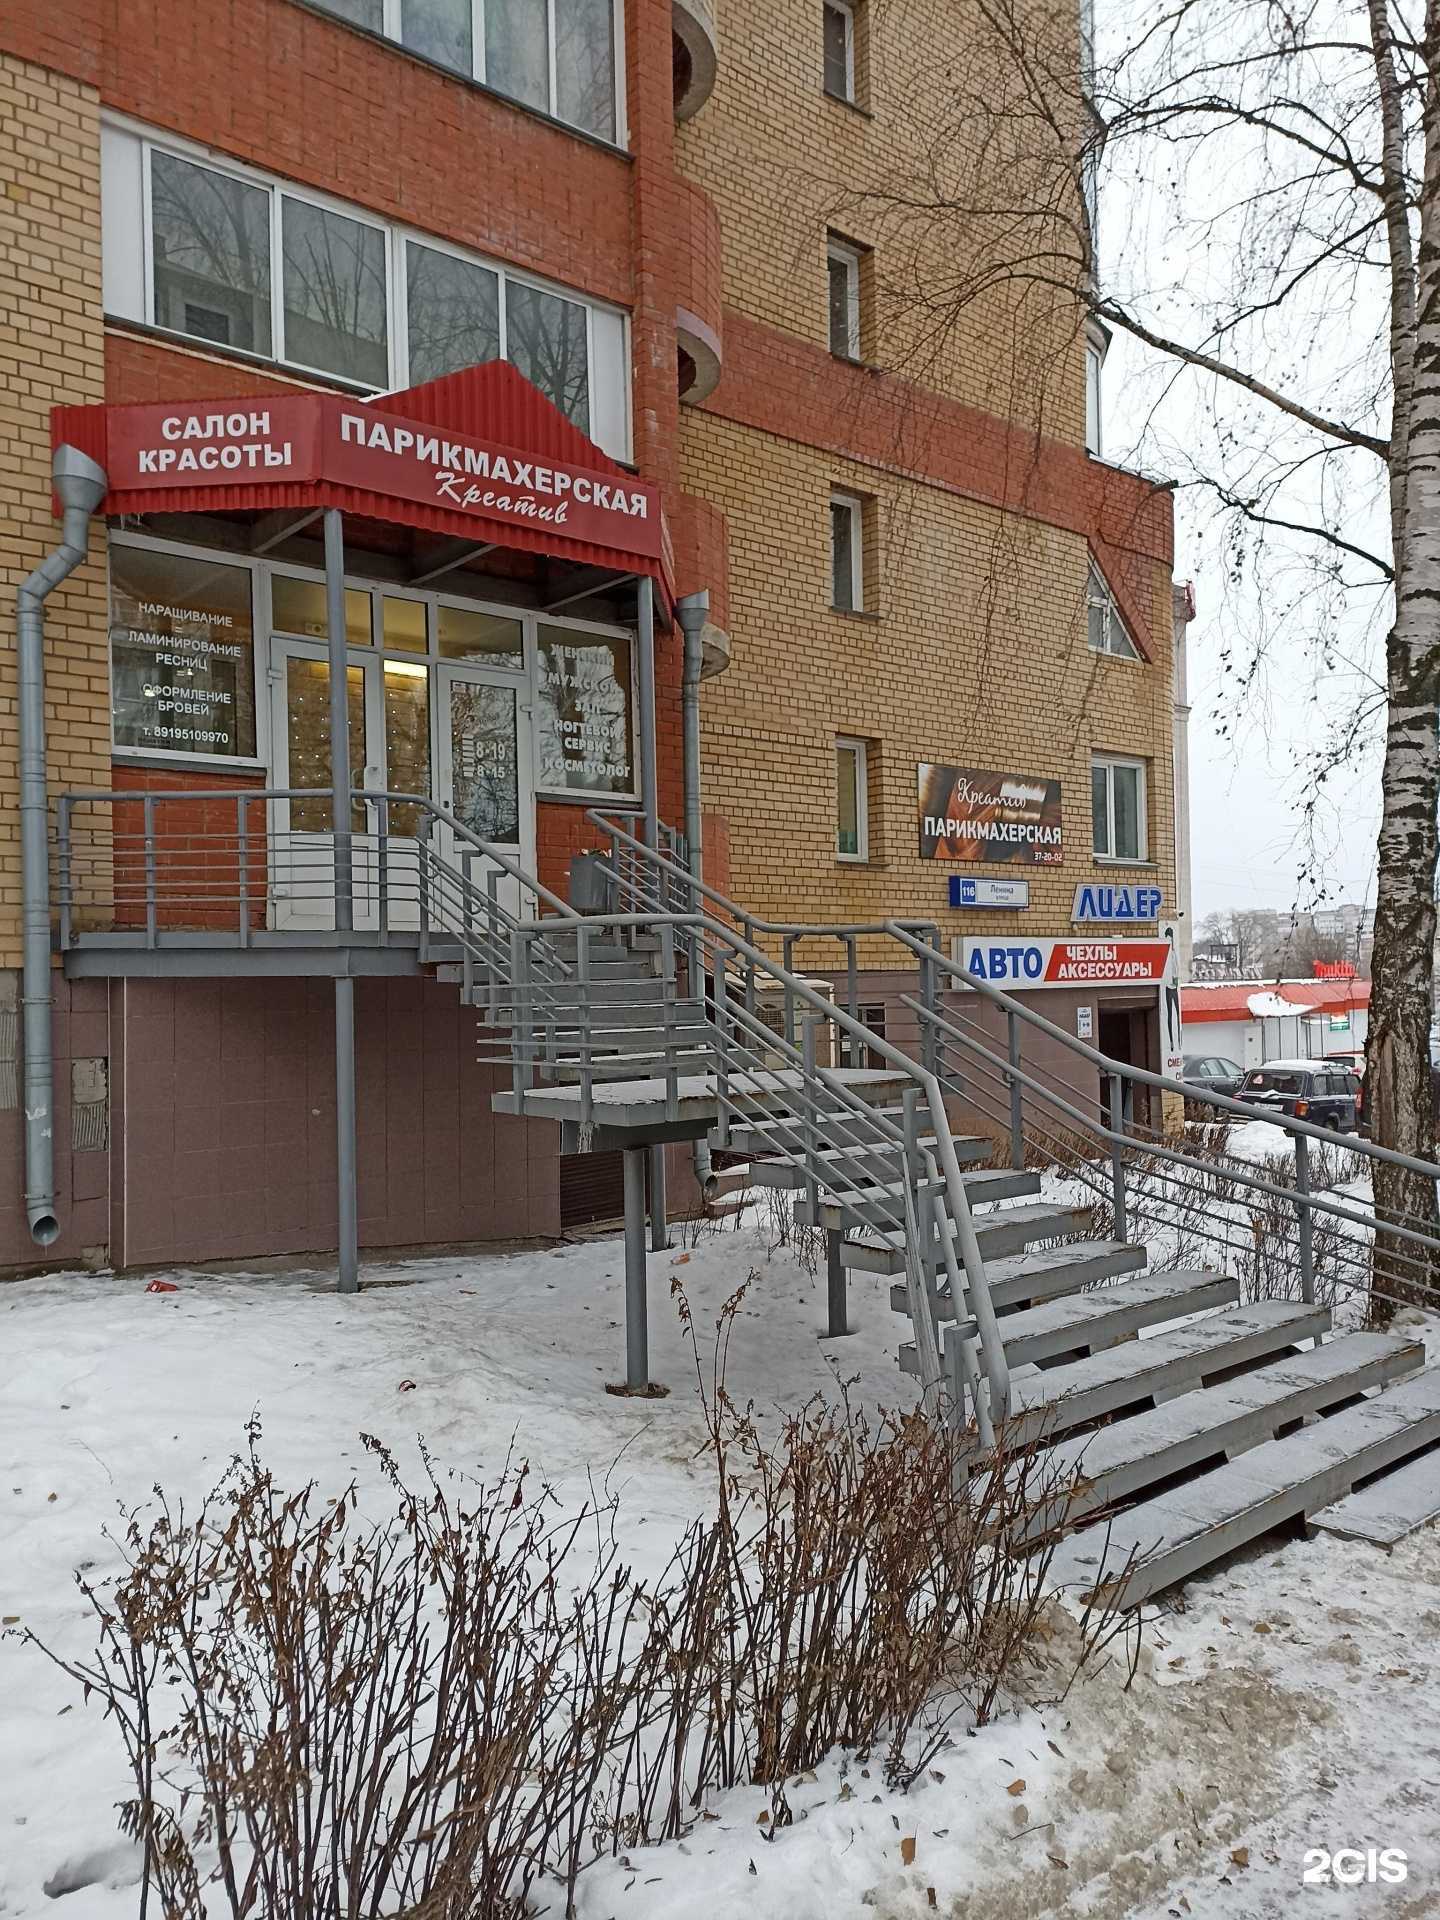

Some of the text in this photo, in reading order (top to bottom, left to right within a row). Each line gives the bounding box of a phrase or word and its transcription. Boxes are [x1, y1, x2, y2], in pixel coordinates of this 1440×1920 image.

[161, 411, 270, 441] САЛОН
[138, 442, 292, 473] КРАСОТЫ
[340, 413, 648, 519] ПАРИКМАХЕРСКАЯ
[434, 470, 569, 524] Креатив
[138, 601, 233, 627] НАРАЩИВАНИЕ
[127, 630, 242, 657] ЛАМИНИРОВАНИЕ
[155, 652, 208, 672] РЕСНИЦ
[142, 683, 232, 704] ОФОРМЛЕНИЕ
[157, 700, 210, 716] БРОВЕЙ
[153, 726, 229, 744] 89195109970
[554, 719, 617, 738] НОГТЕВОЙ
[564, 737, 611, 754] СЕРВИС
[924, 816, 1061, 844] ПАРИКМАХЕРСКАЯ
[1034, 851, 1063, 861] 37-20-02
[962, 886, 975, 897] 116
[1079, 887, 1162, 918] ЛИДЕР
[968, 947, 1043, 979] АВТО
[1066, 945, 1117, 960] ЧЕХЛЫ
[1058, 962, 1152, 978] АКСЕССУАРЫ
